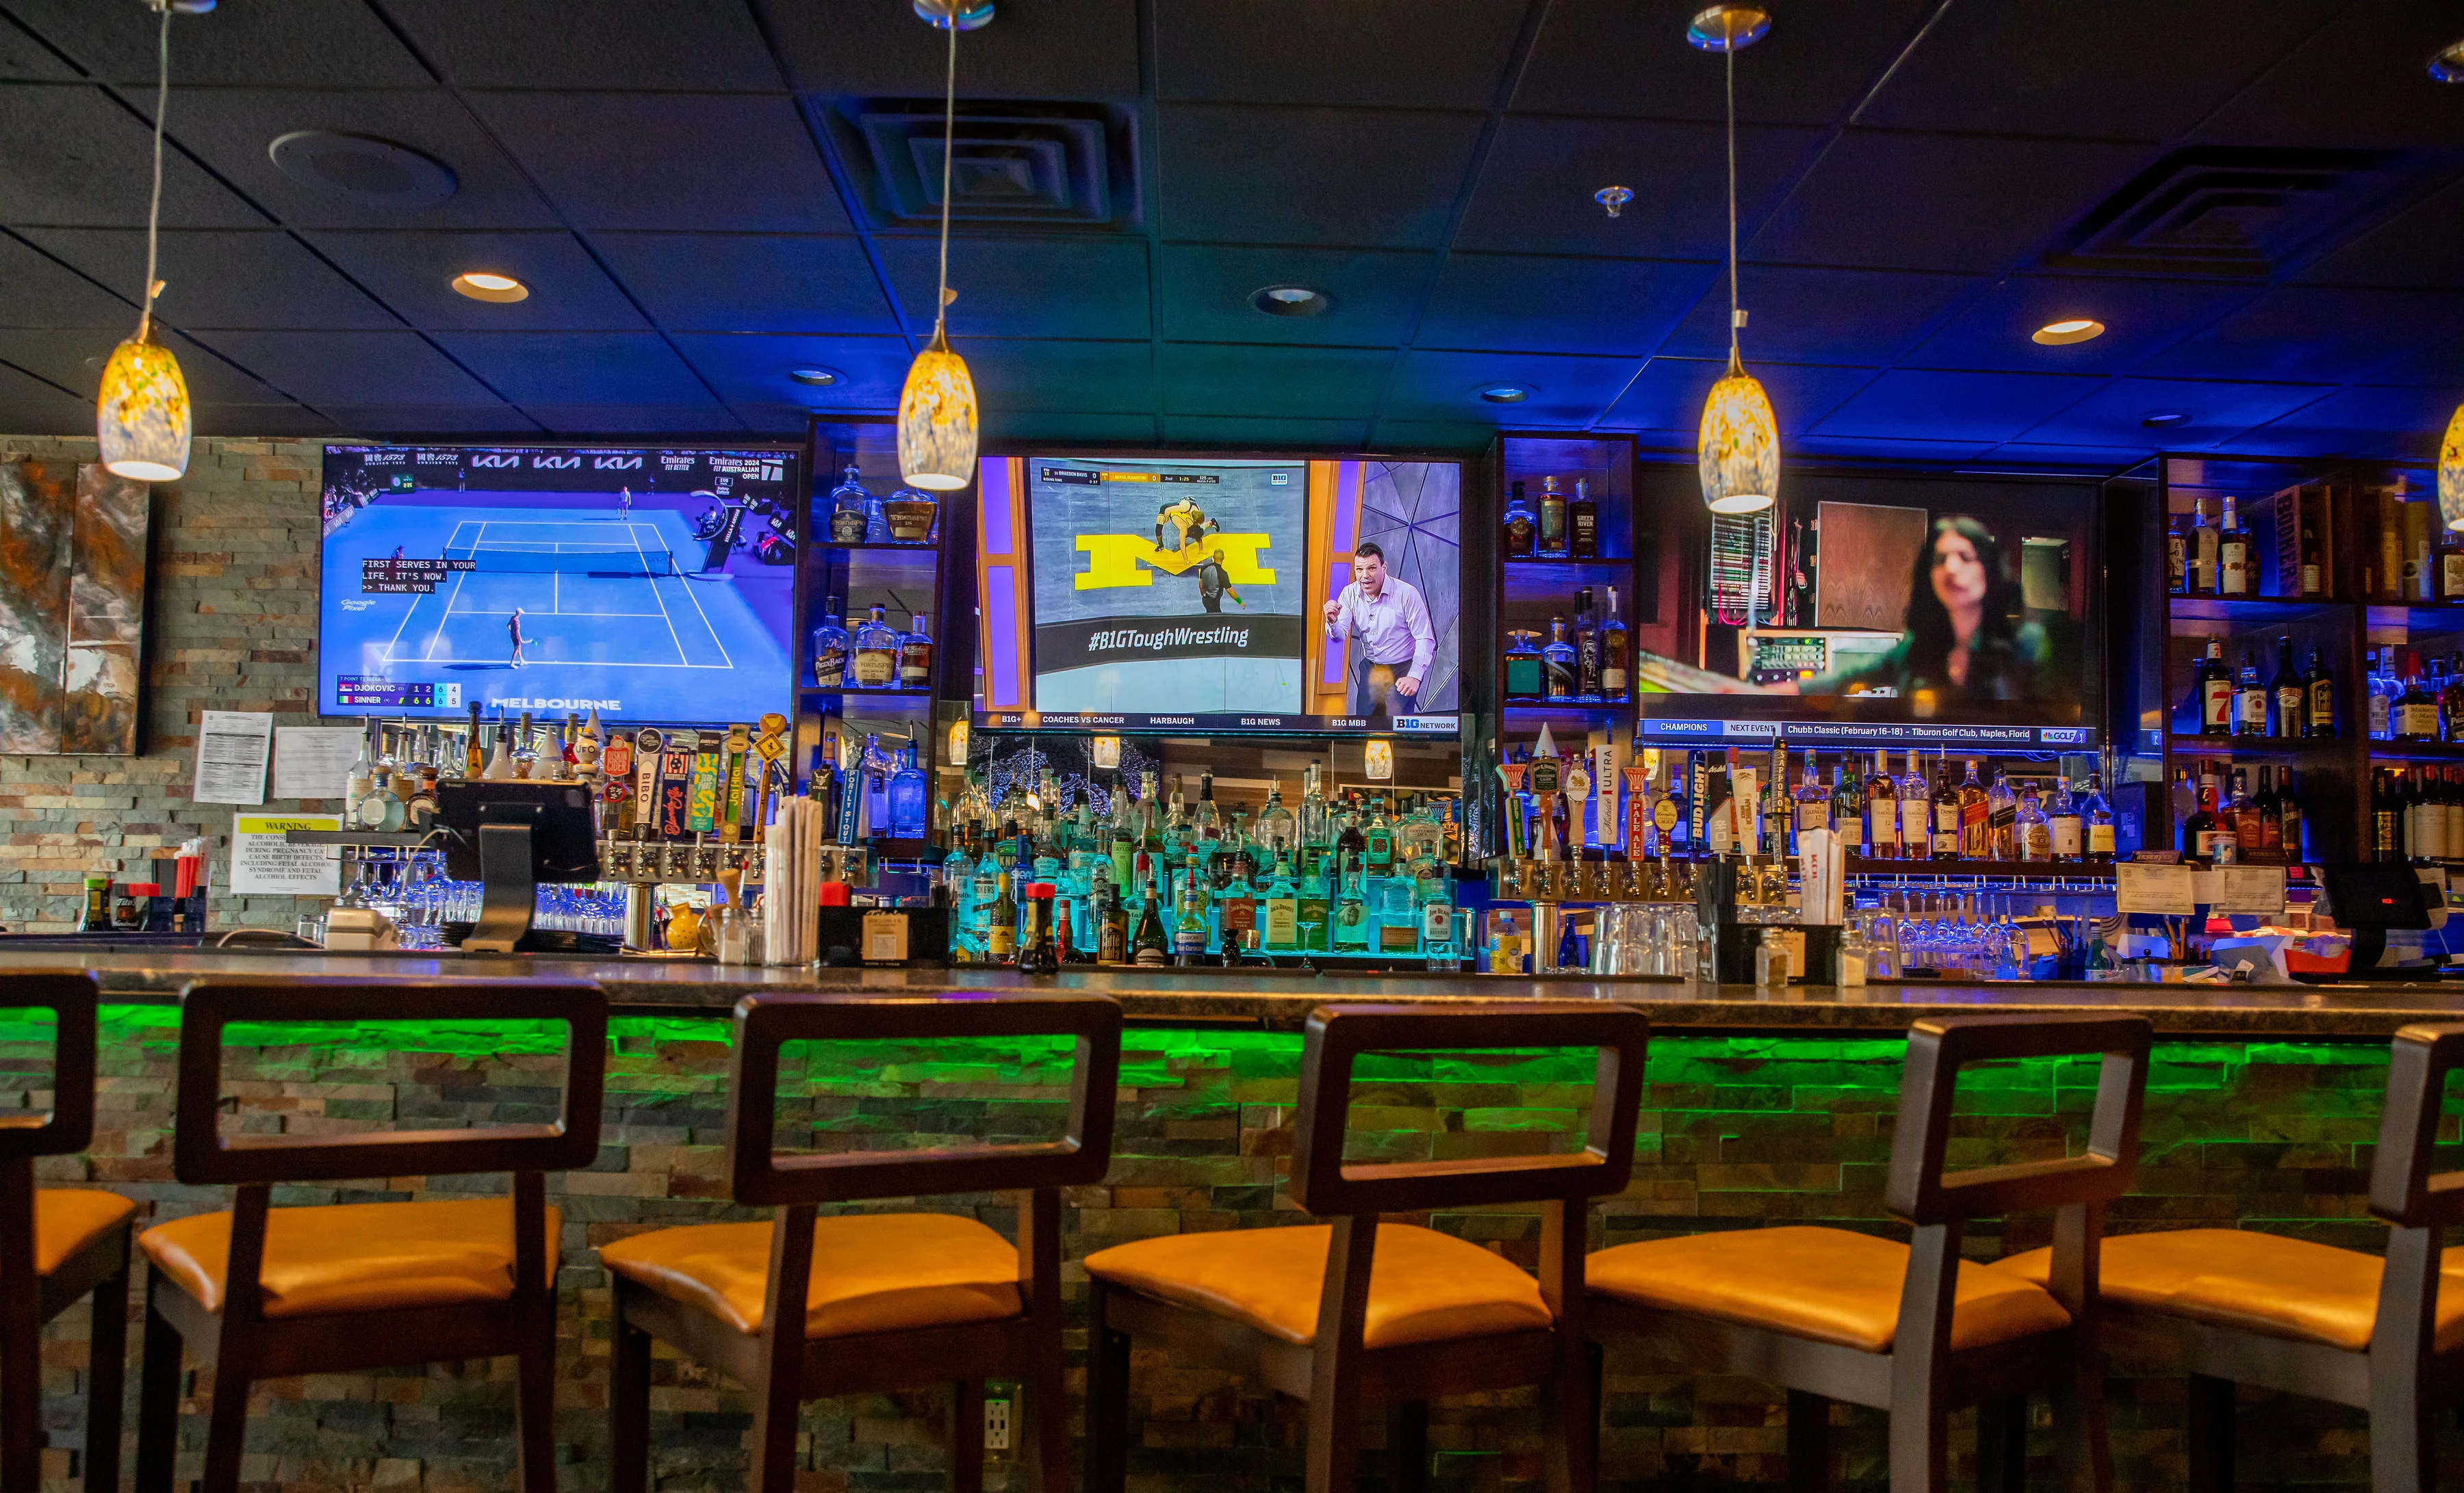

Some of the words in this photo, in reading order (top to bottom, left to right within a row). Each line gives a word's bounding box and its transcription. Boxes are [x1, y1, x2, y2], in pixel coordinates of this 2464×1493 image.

[472, 454, 519, 468] KIA
[533, 456, 580, 469] KIA
[594, 456, 642, 469] KIA
[660, 456, 695, 465] Emirates
[709, 456, 743, 465] Emirates
[363, 572, 389, 581] LIFE,
[1088, 627, 1249, 651] #B1GToughWrestling
[491, 698, 621, 711] MELBOURNE
[1660, 723, 1708, 731] CHAMPIONS
[1788, 725, 1813, 734] Chubb
[1814, 725, 1840, 734] Classic
[1841, 727, 1877, 737] (February
[1912, 728, 1941, 736] Tiburon
[1942, 728, 1958, 736] Golf
[1959, 729, 1978, 738] Club,
[1980, 729, 2008, 739] Naples,
[608, 761, 626, 772] CIDER
[1604, 750, 1613, 788] ULTRA
[640, 773, 651, 803] BIBO
[847, 772, 856, 808] PORTLY
[1693, 764, 1705, 806] LIGHT
[265, 822, 311, 831] WARNING
[1693, 808, 1704, 838] BUD
[1437, 908, 1450, 916] BEAM
